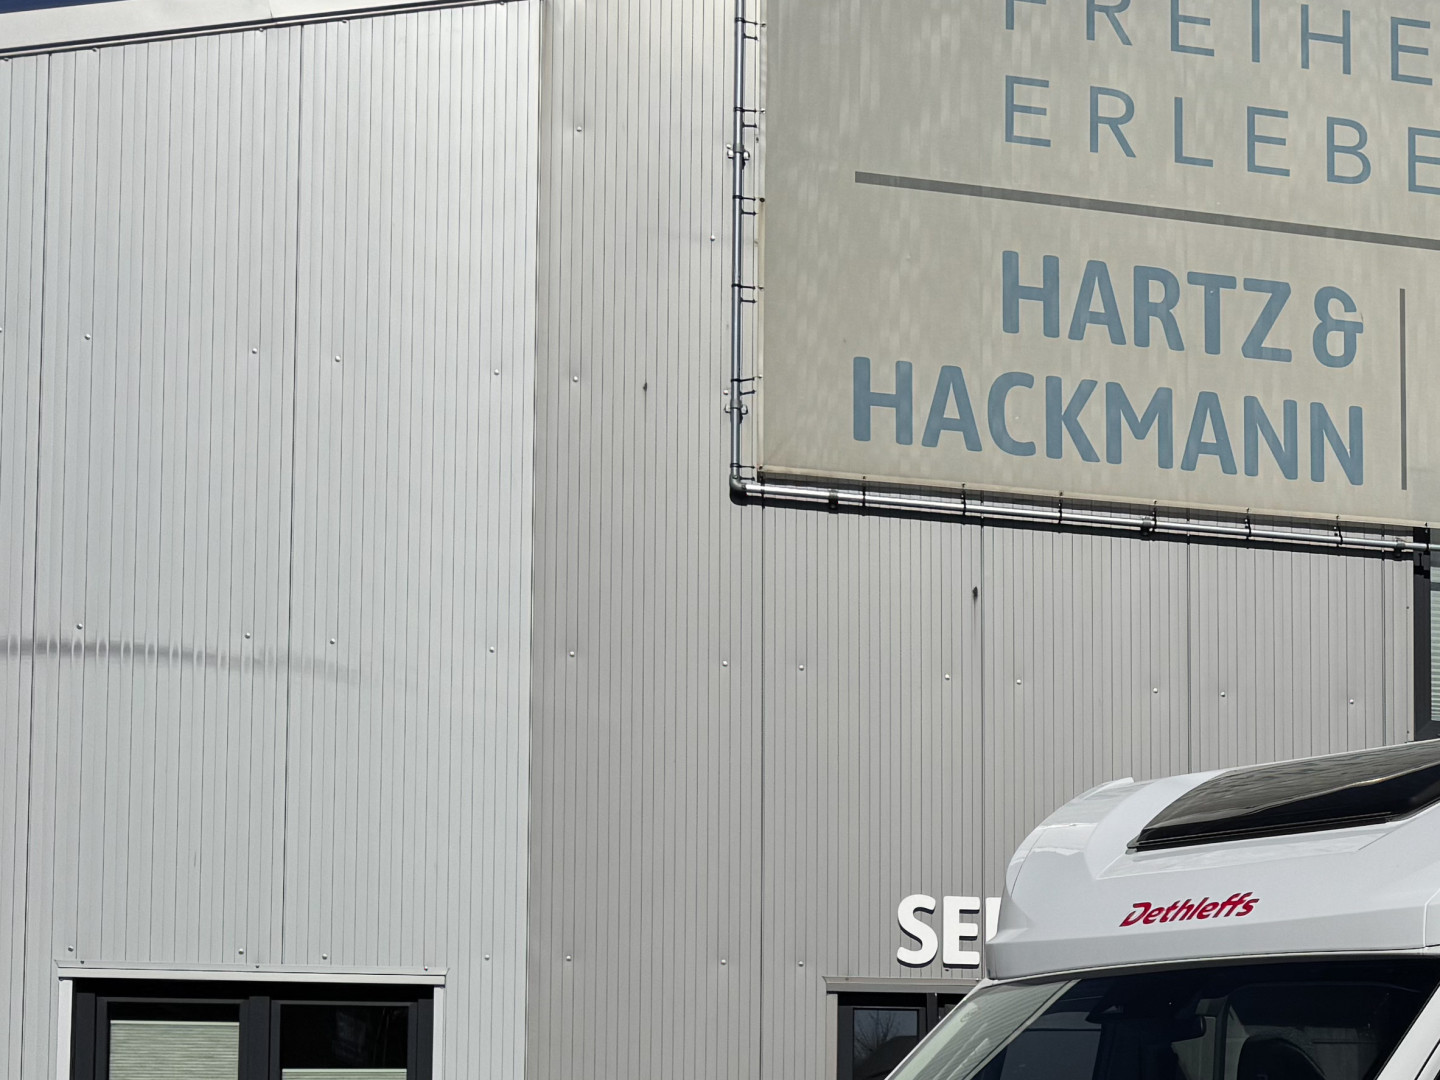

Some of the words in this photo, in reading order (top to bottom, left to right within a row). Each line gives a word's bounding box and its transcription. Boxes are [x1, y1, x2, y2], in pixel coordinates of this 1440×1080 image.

[1002, 250, 1293, 363] HARTZ
[1313, 286, 1364, 368] &
[852, 357, 1364, 486] HACKMANN
[1119, 892, 1260, 927] Dethleffs
